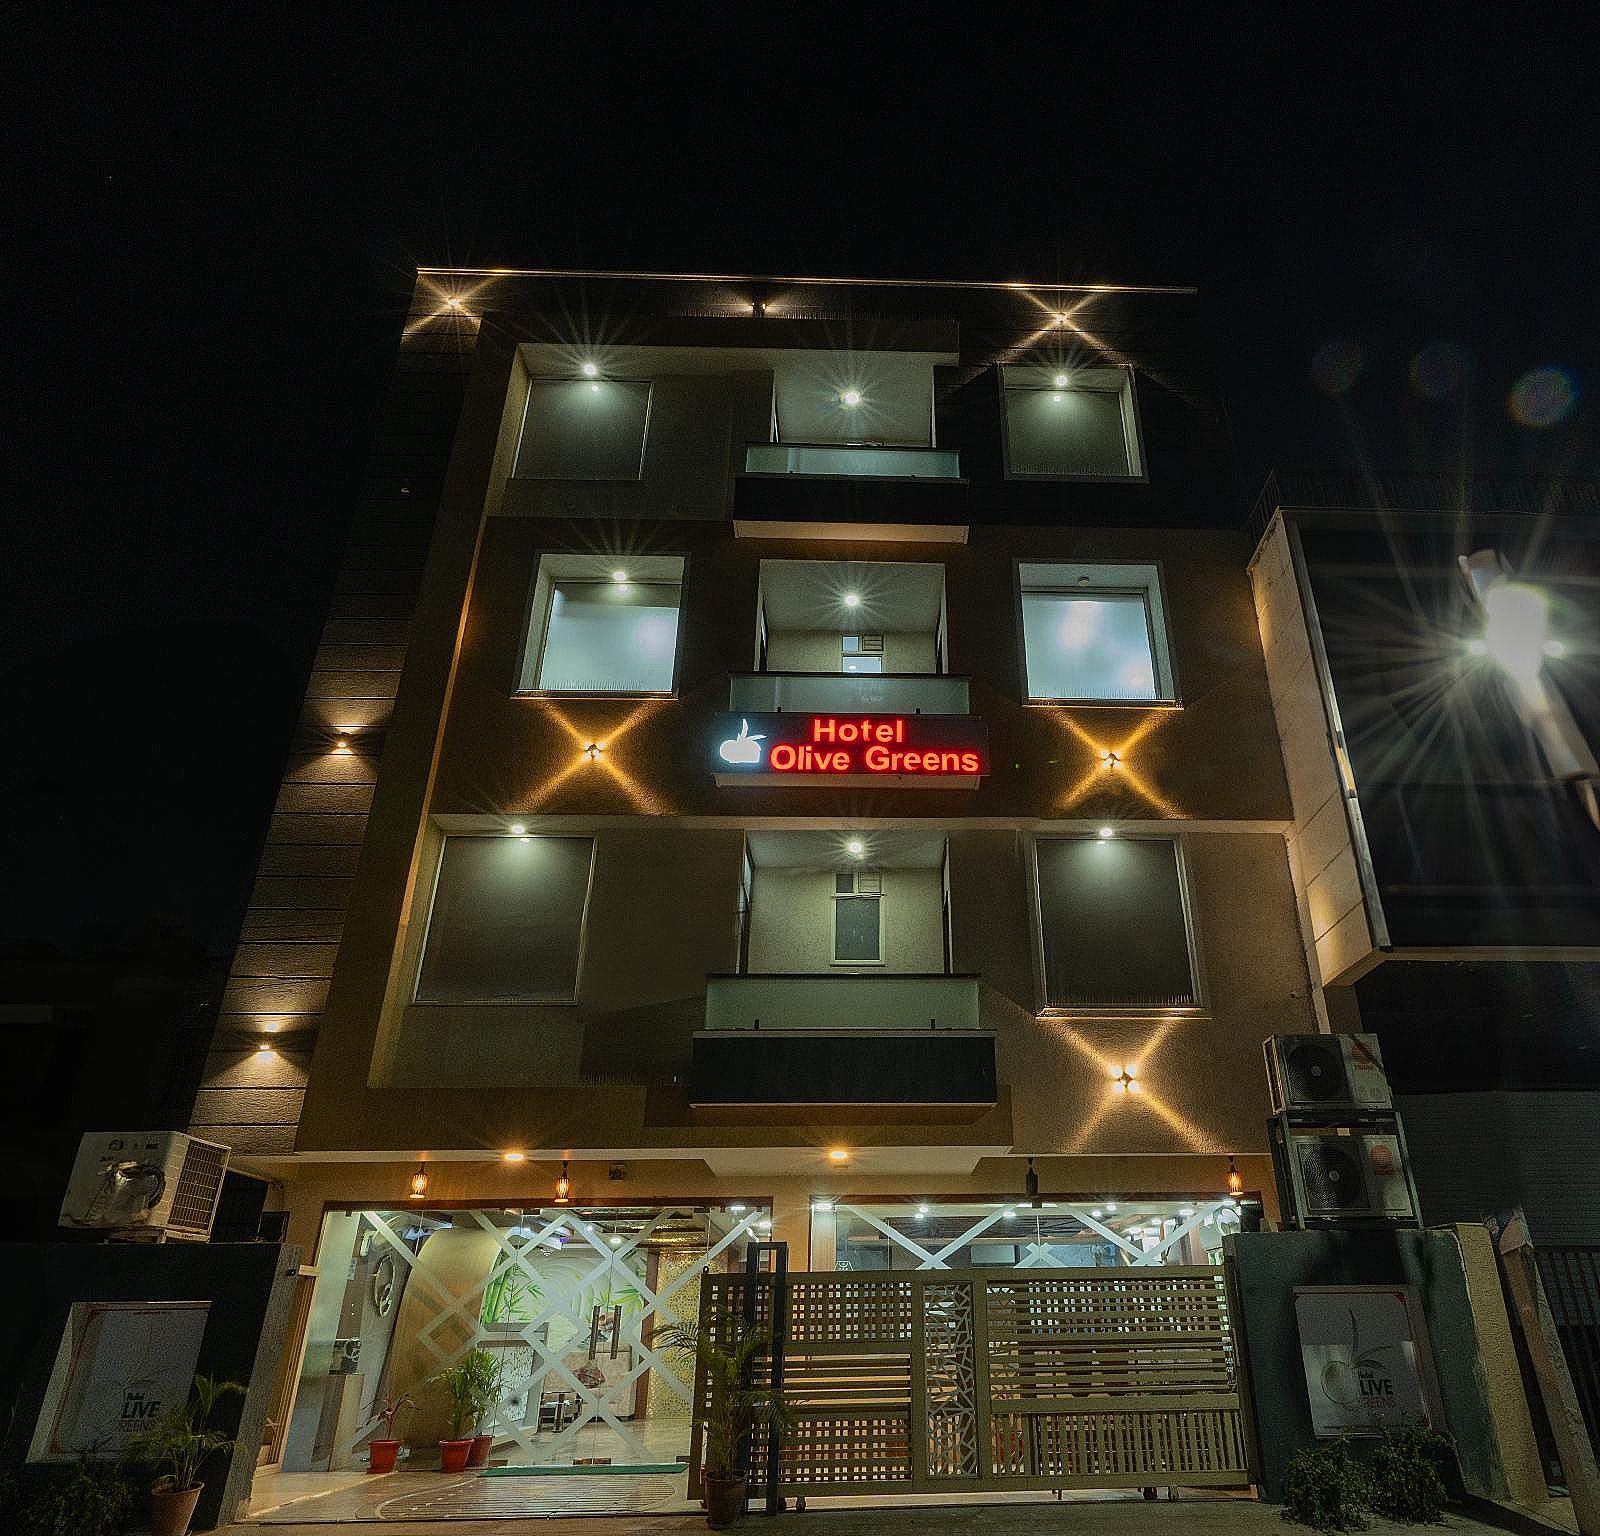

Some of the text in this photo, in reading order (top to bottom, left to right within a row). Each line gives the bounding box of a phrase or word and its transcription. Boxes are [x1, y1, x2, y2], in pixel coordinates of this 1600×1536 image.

[813, 719, 903, 743] Hotel
[770, 745, 979, 772] Olive Greens
